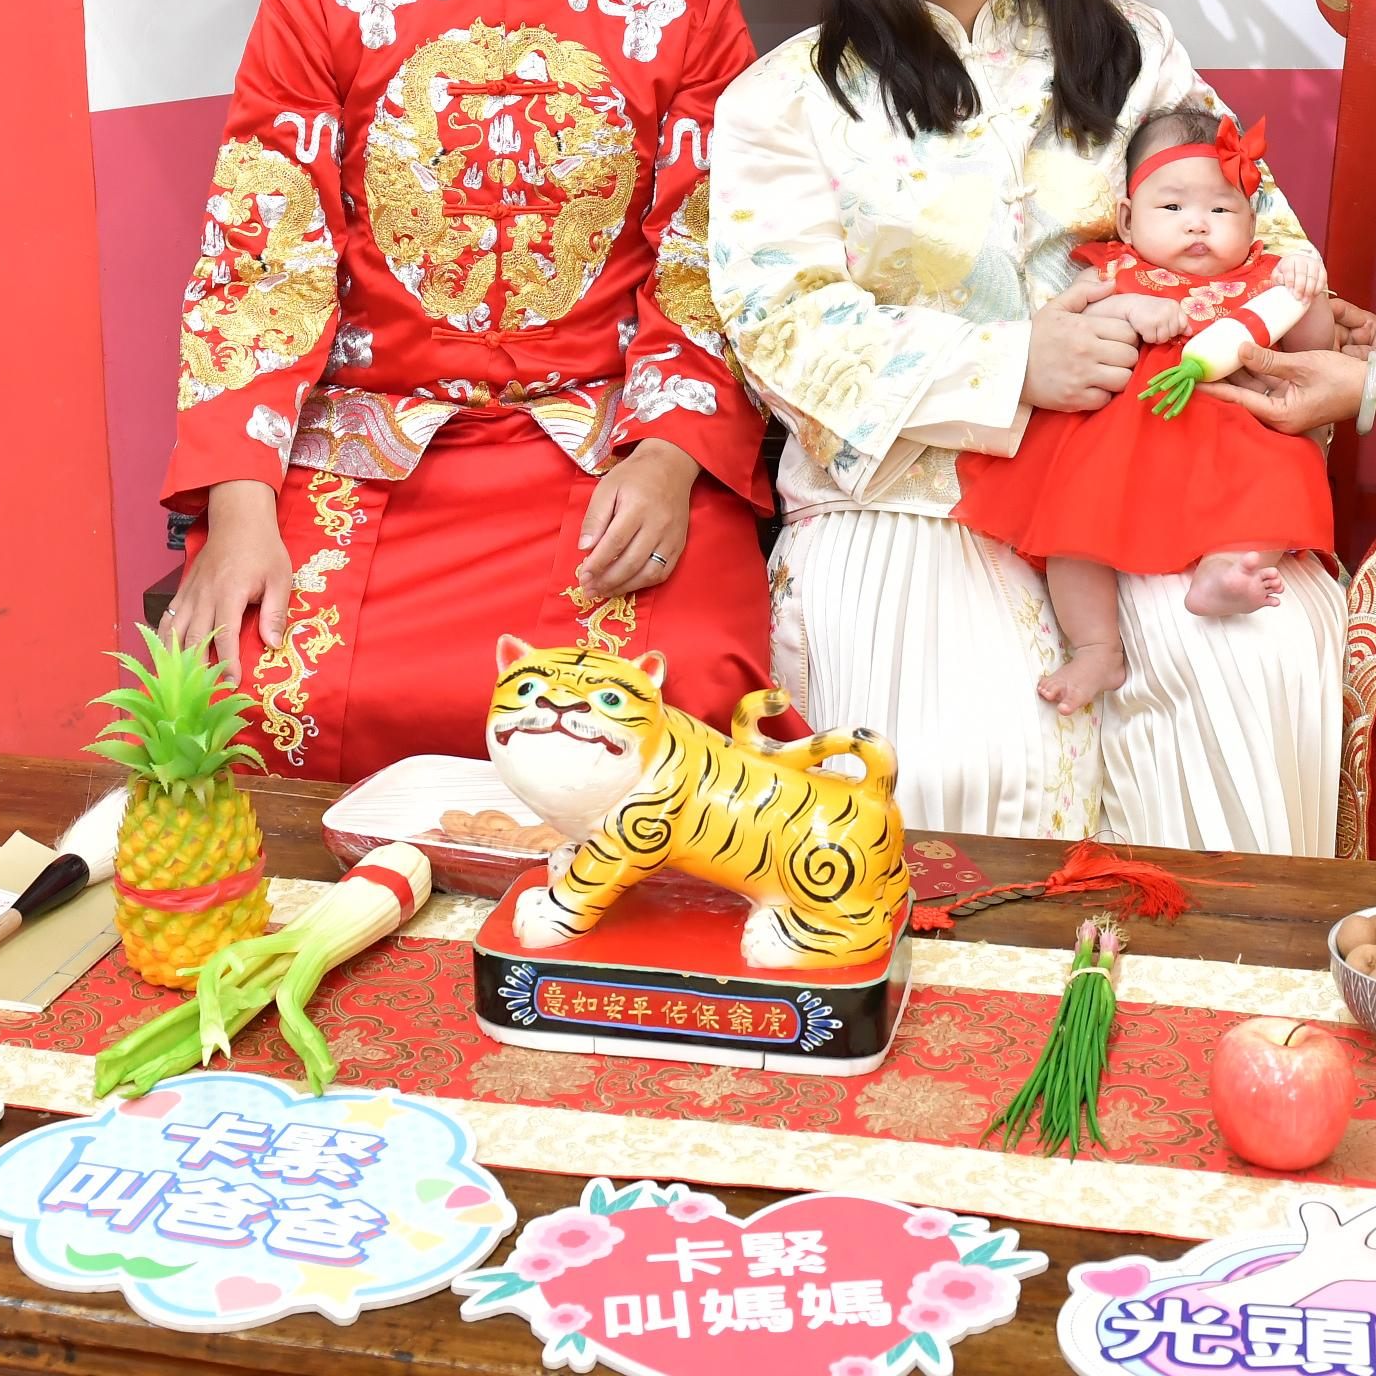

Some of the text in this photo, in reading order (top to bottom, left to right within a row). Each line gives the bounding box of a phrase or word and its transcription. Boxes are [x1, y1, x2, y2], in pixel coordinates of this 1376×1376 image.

[163, 1111, 387, 1189] 卡緊
[38, 1161, 389, 1267] 叫爸爸
[645, 1229, 829, 1283] 卡緊
[603, 1278, 893, 1339] 叫媽媽
